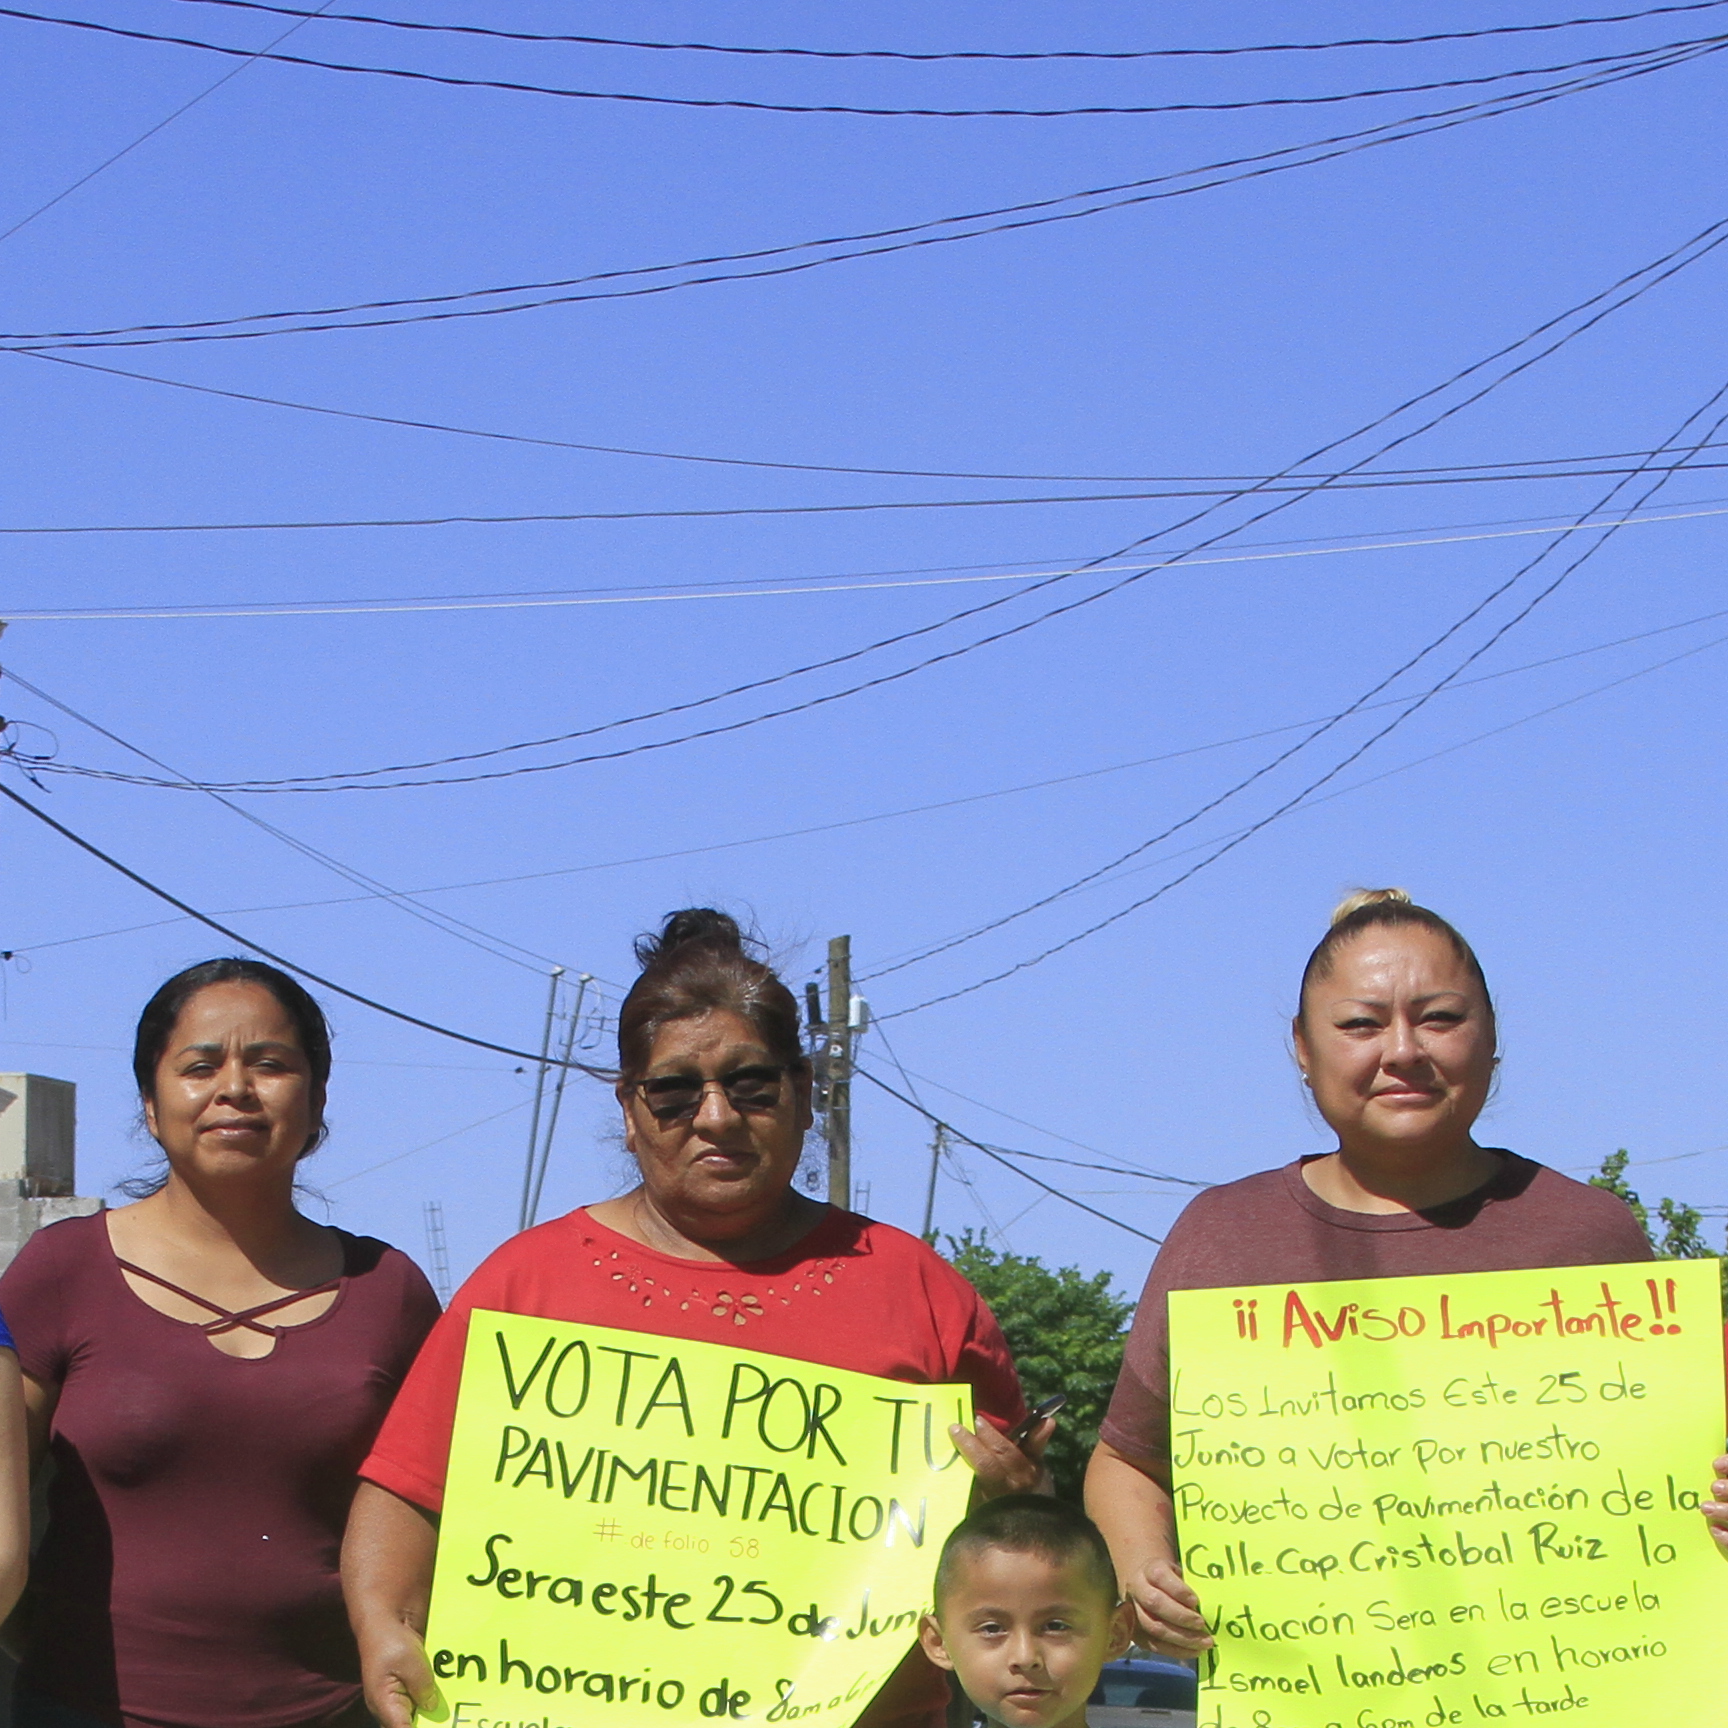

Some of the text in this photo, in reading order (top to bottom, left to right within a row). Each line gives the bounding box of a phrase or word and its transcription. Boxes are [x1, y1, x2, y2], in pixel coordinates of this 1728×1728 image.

[495, 1330, 965, 1476] VOTA POR TU
[1258, 1369, 1427, 1419] Invitamos
[1442, 1370, 1518, 1409] Este
[1534, 1370, 1589, 1406] 25
[1598, 1359, 1648, 1402] de
[1173, 1427, 1267, 1470] Junio
[1479, 1422, 1601, 1465] nuestro
[493, 1424, 928, 1549] PAVIMENTACION
[1171, 1466, 1702, 1526] Proyecto de de la
[629, 1530, 761, 1560] de folio 58
[1348, 1520, 1678, 1573] Cristobal Ruiz la
[704, 1574, 785, 1626] 25
[786, 1602, 842, 1643] de
[845, 1586, 935, 1641] Juni
[1448, 1602, 1487, 1624] en
[1497, 1587, 1530, 1623] la
[1539, 1579, 1662, 1619] escuela
[432, 1637, 753, 1721] en horario de
[1199, 1643, 1323, 1696] Ismael
[1486, 1649, 1541, 1677] en
[1549, 1633, 1669, 1673] horario
[1424, 1694, 1465, 1728] de
[1471, 1692, 1509, 1720] la
[1510, 1683, 1591, 1717] tarde
